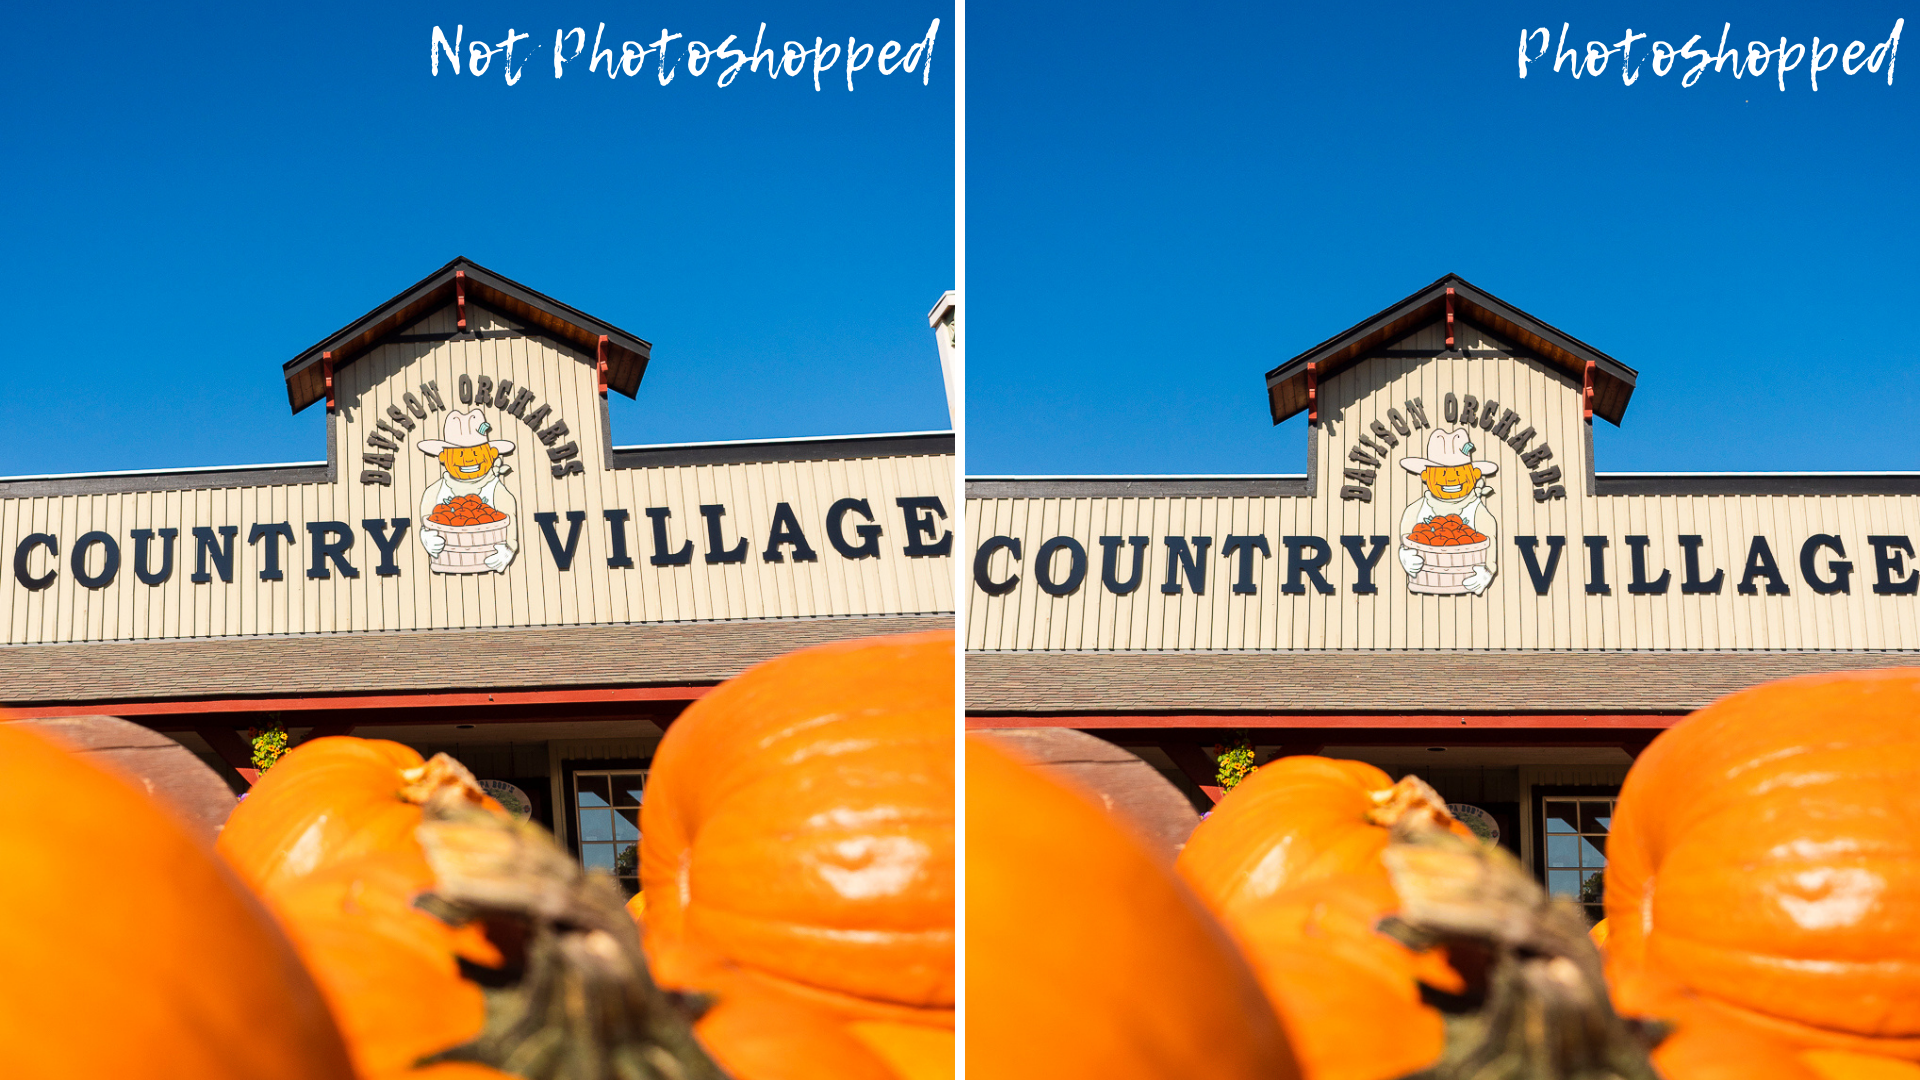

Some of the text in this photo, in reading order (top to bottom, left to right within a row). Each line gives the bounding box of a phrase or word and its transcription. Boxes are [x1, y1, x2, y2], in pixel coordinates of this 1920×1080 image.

[360, 373, 584, 487] DAVISON ORCHARDS
[1340, 392, 1567, 503] DAVISON ORCHARDS
[14, 496, 953, 590] COUNTRY VILLAGE
[973, 533, 1920, 596] COUNTRY VILLAGE
